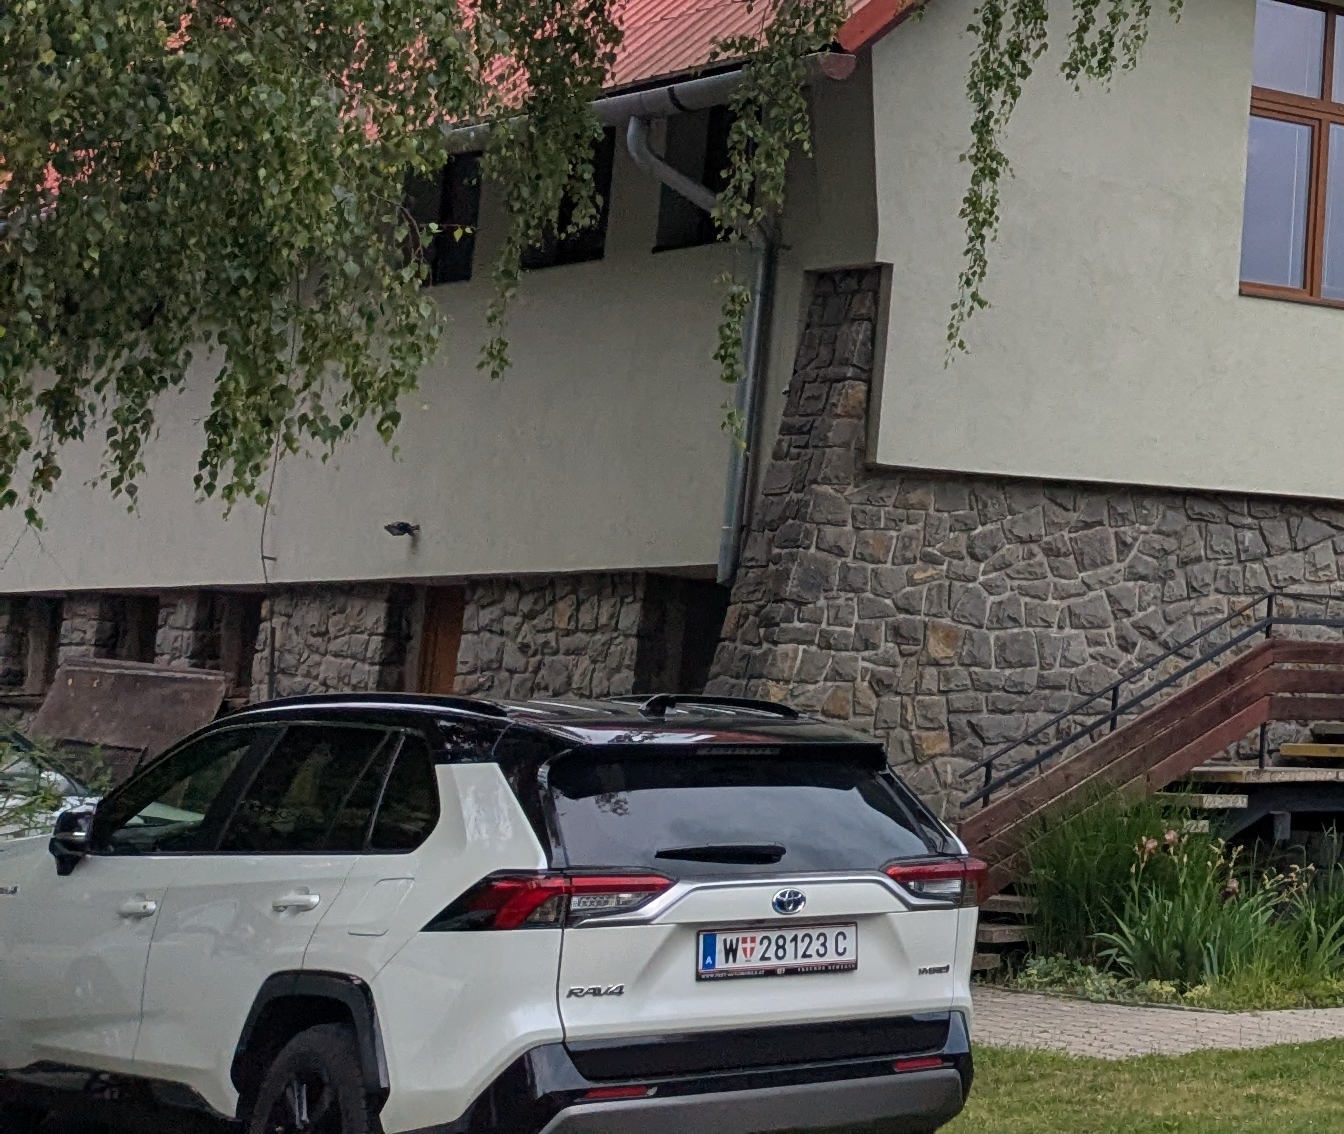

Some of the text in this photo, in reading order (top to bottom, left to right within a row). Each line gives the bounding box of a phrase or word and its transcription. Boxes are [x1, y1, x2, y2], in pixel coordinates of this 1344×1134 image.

[705, 930, 847, 965] A W 28123 C
[566, 983, 625, 999] RAV4
